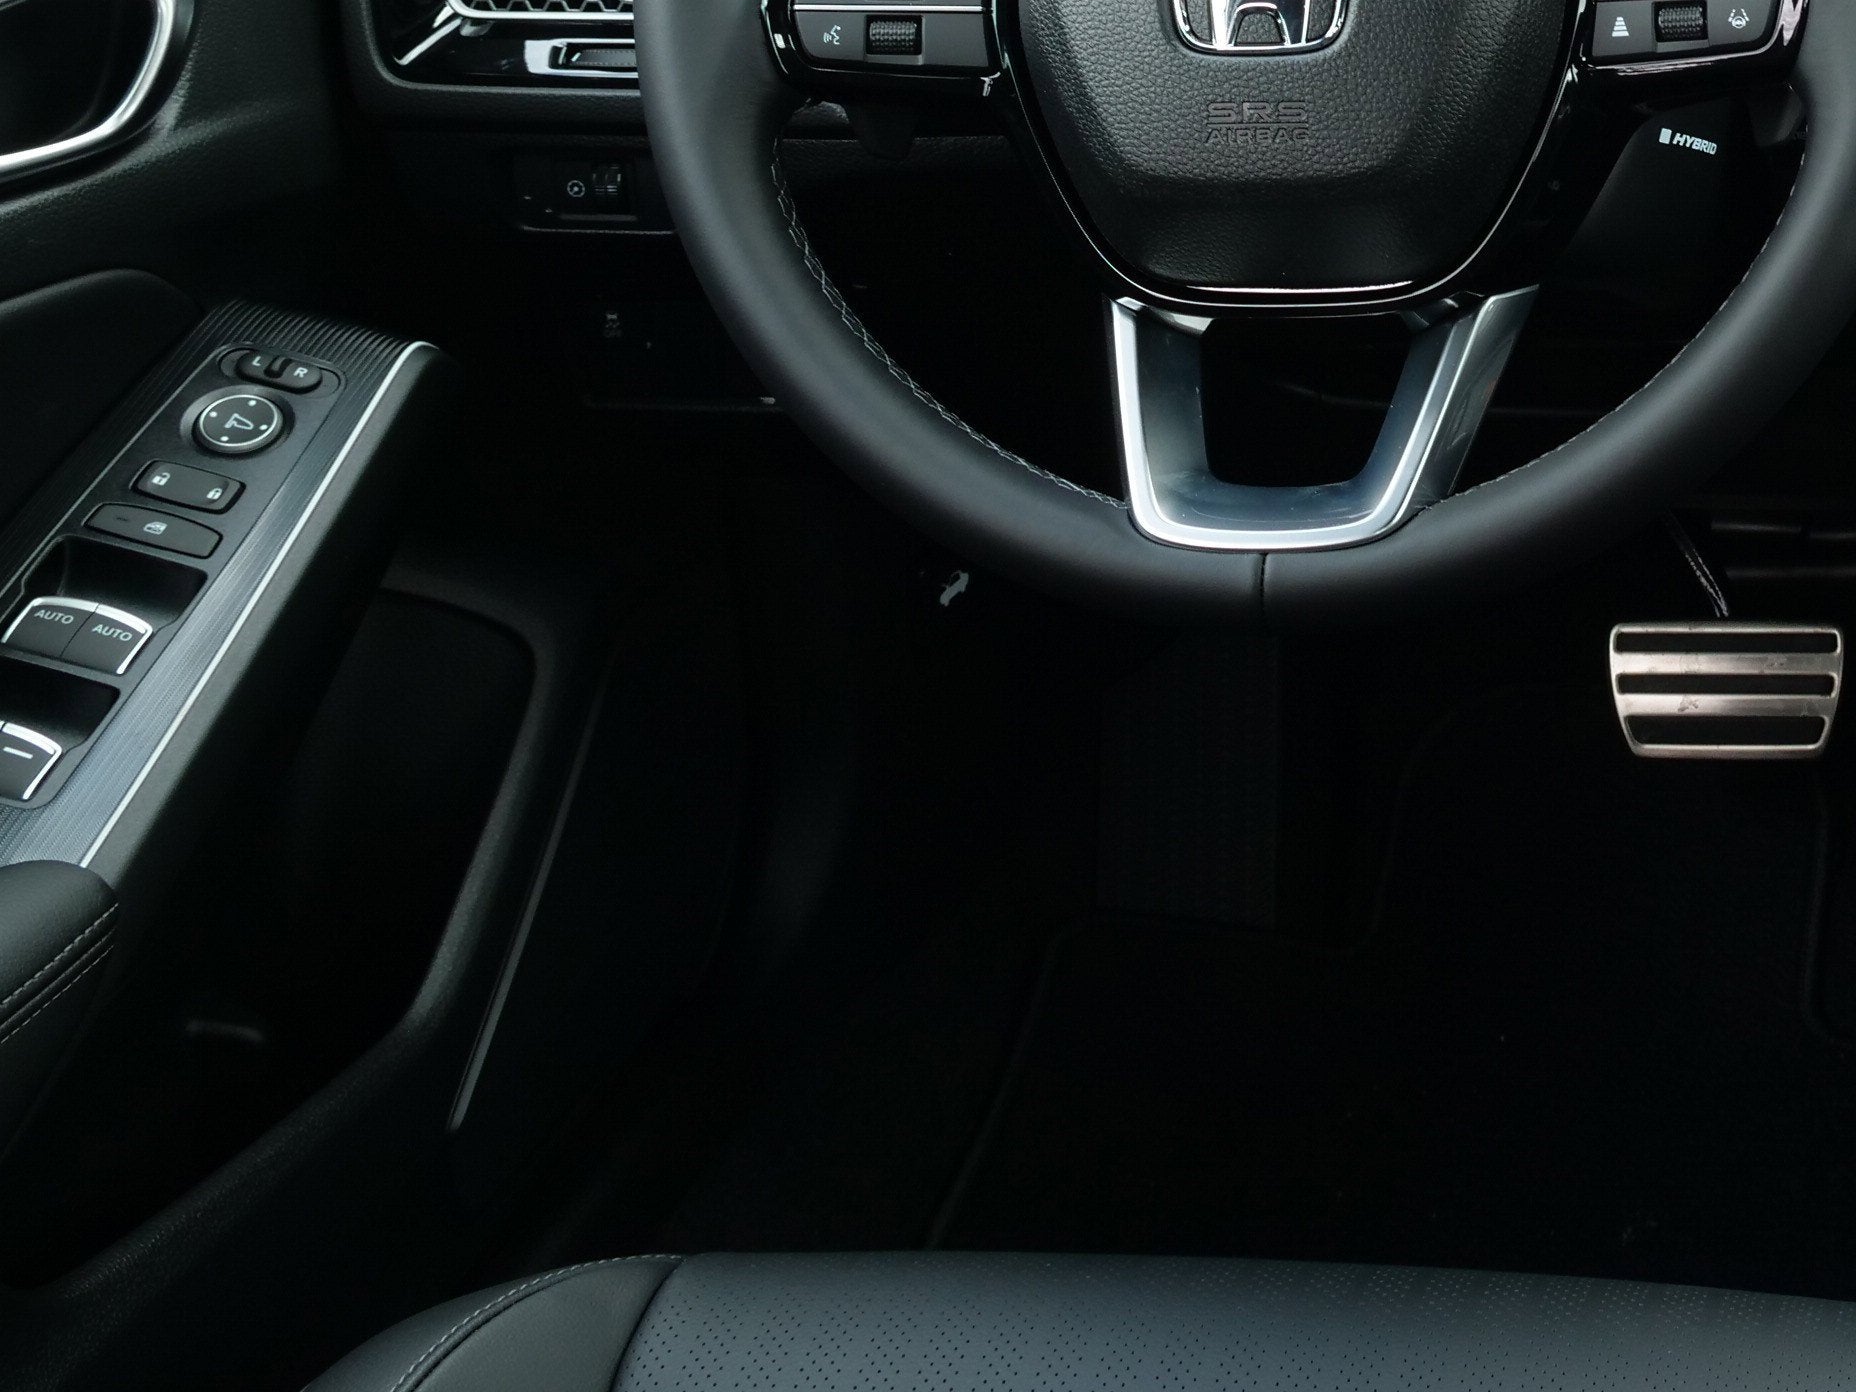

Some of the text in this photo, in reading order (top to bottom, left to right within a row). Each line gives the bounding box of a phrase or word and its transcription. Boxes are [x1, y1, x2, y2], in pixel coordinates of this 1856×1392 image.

[1205, 100, 1308, 123] SRS
[1203, 127, 1310, 144] AIRBAG
[1672, 132, 1718, 156] HYBRID
[251, 355, 262, 367] L
[293, 366, 309, 378] R
[34, 609, 74, 625] AUTO
[91, 623, 133, 642] AUTO
